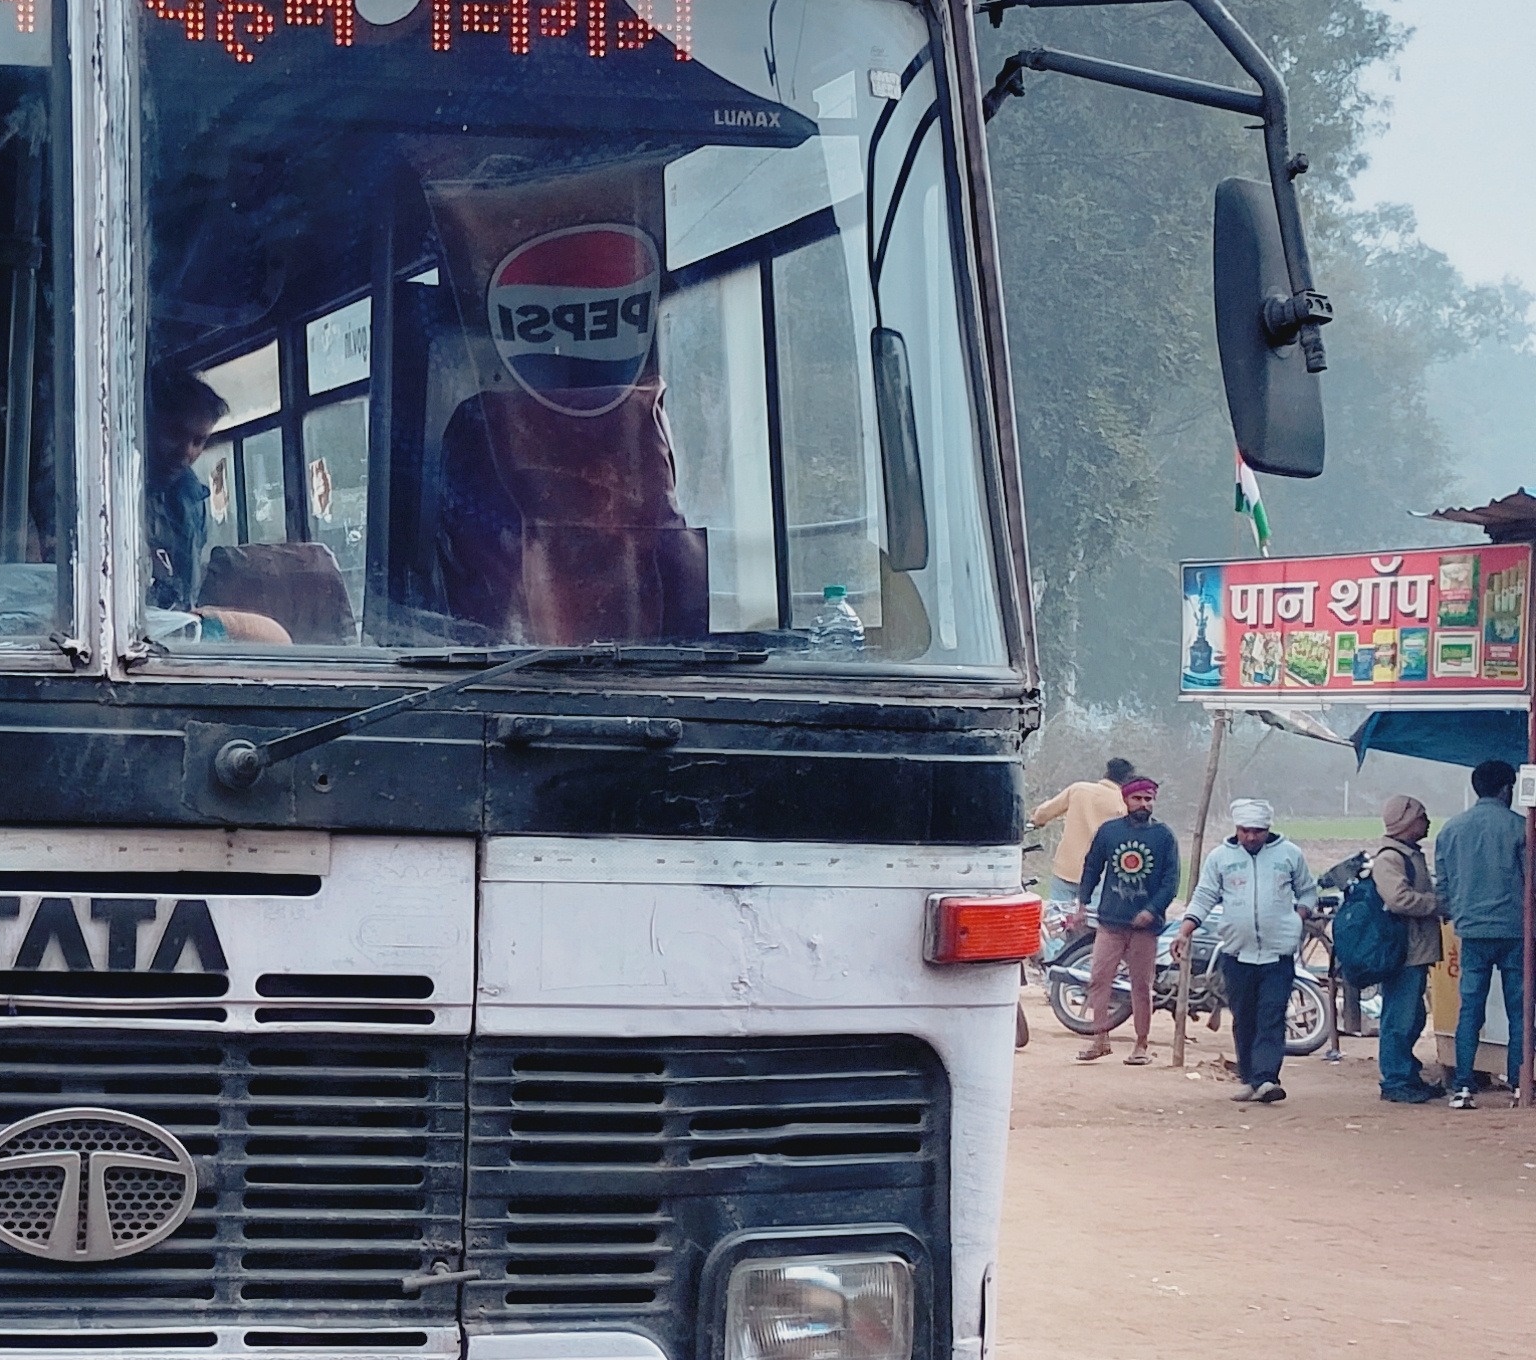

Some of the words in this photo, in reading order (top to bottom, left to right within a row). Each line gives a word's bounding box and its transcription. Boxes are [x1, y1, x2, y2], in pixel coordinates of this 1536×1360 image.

[713, 109, 781, 128] LUMAX
[1229, 581, 1319, 626] पान
[1327, 555, 1434, 623] शॉप
